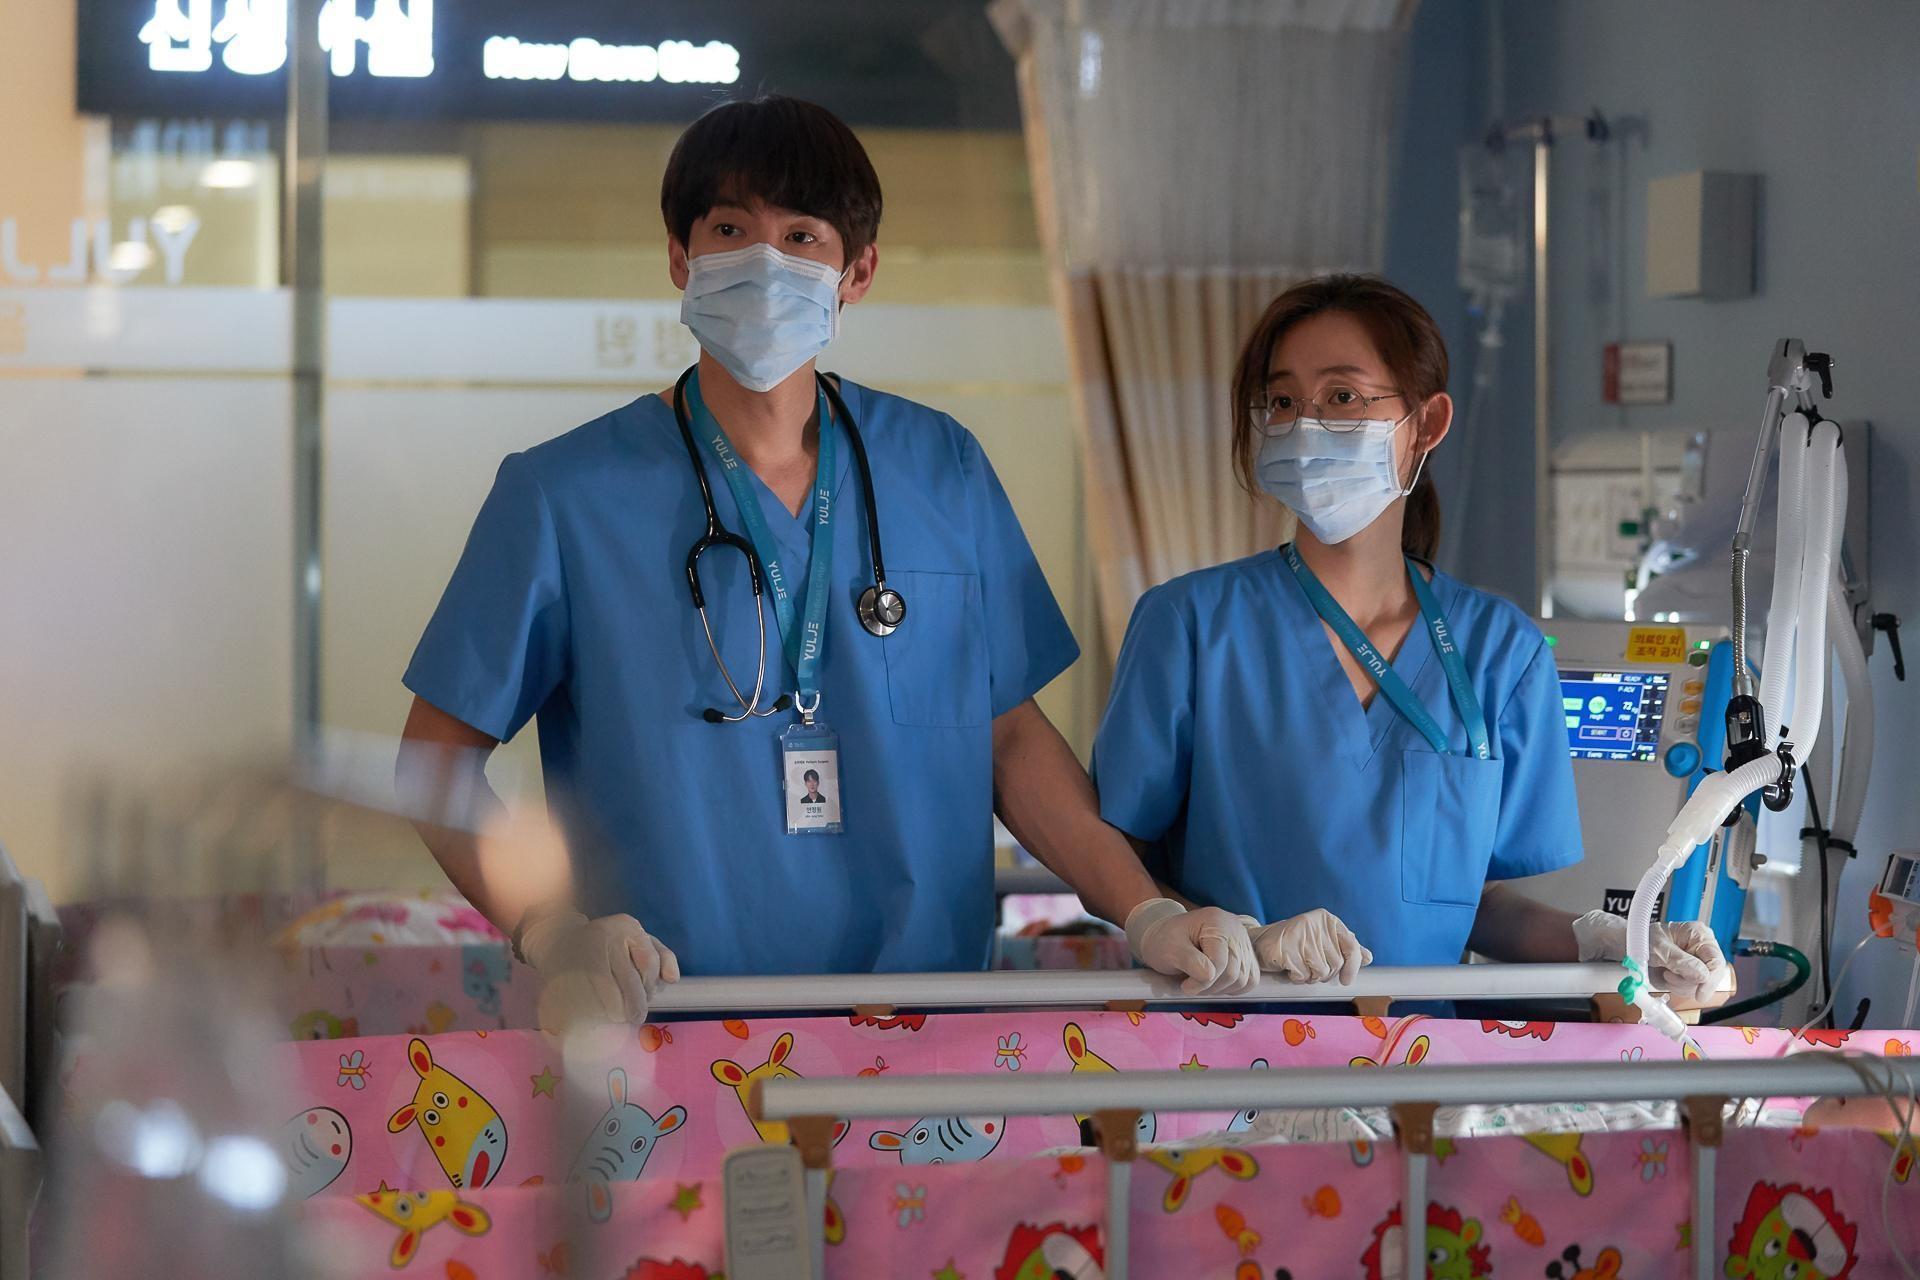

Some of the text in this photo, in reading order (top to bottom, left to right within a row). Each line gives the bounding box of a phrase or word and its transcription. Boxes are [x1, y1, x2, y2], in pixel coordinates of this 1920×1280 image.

[711, 434, 738, 470] YULJE
[818, 488, 830, 525] YULJE
[767, 561, 787, 600] YULJE
[803, 621, 819, 662] YULJE
[1433, 617, 1453, 654] YULJE
[1634, 634, 1665, 645] 의료인
[1660, 647, 1681, 657] 금지
[1357, 643, 1387, 678] YULJE
[1607, 897, 1660, 914] YUE
